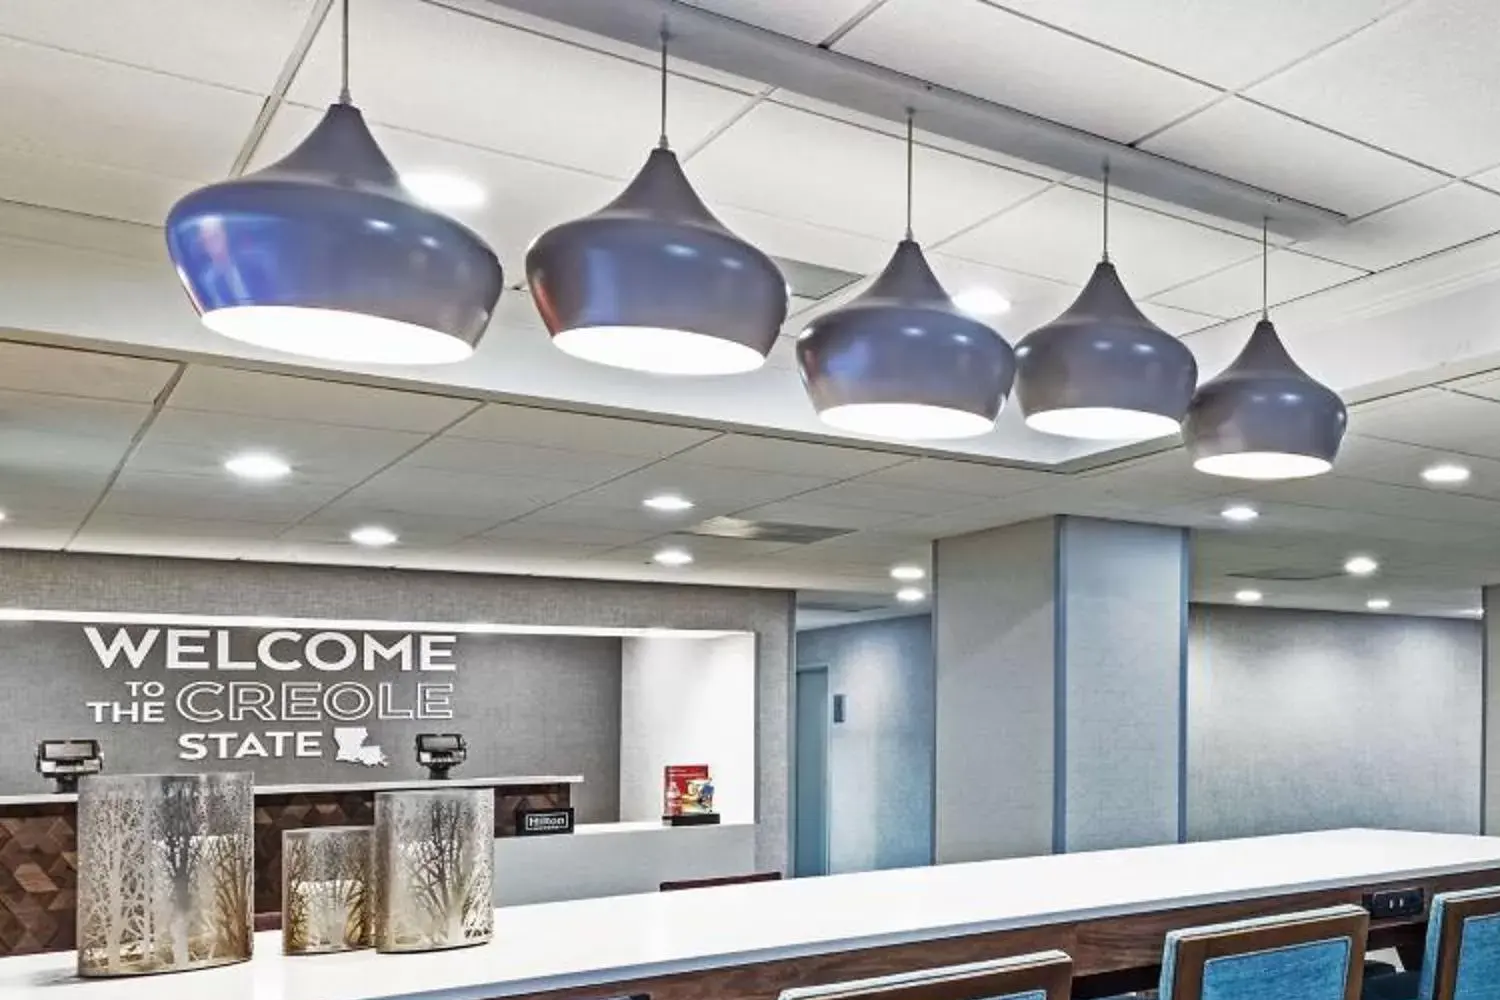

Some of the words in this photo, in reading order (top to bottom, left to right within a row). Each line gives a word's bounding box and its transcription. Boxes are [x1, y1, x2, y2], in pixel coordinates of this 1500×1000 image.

[83, 626, 457, 671] WELCOME
[84, 701, 165, 723] THE
[176, 681, 453, 723] CREOLE
[124, 681, 165, 697] TO
[178, 731, 323, 760] STATE
[529, 817, 565, 827] Hilton
